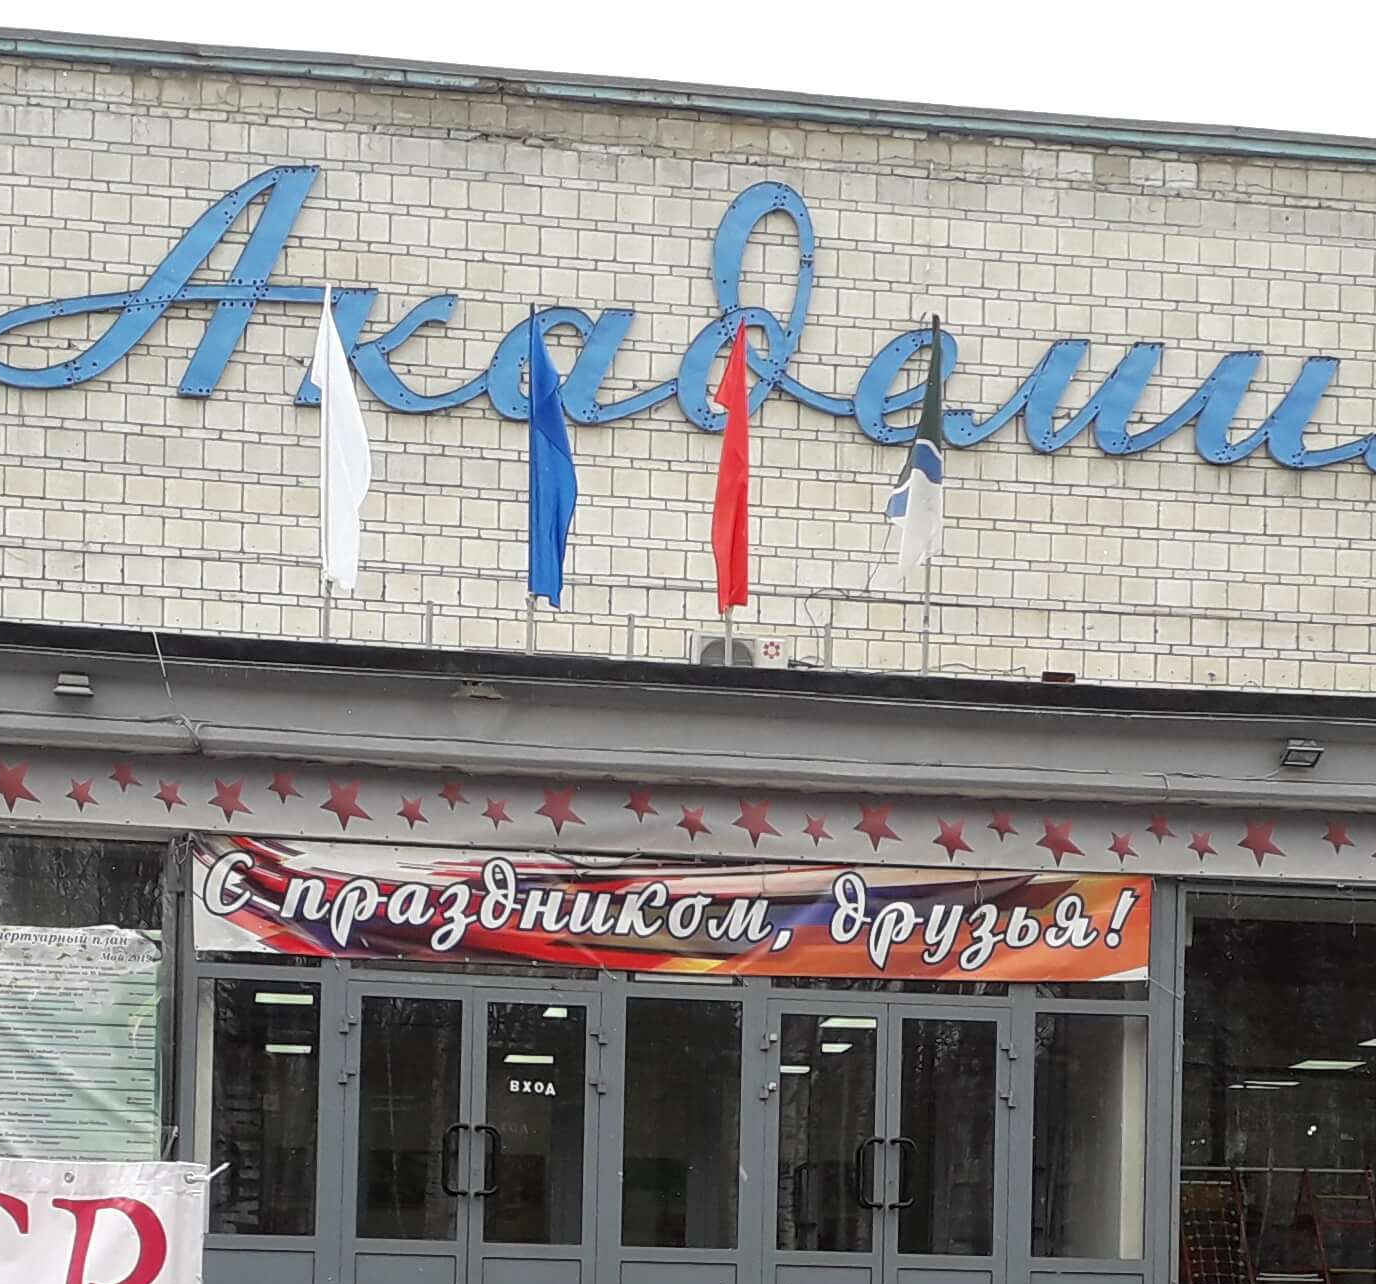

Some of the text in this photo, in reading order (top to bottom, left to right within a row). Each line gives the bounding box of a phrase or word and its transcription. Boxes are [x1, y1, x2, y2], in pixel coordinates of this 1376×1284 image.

[202, 850, 1141, 971] С праздником, друзья!
[89, 934, 128, 947] план
[509, 1079, 557, 1097] ВХОД
